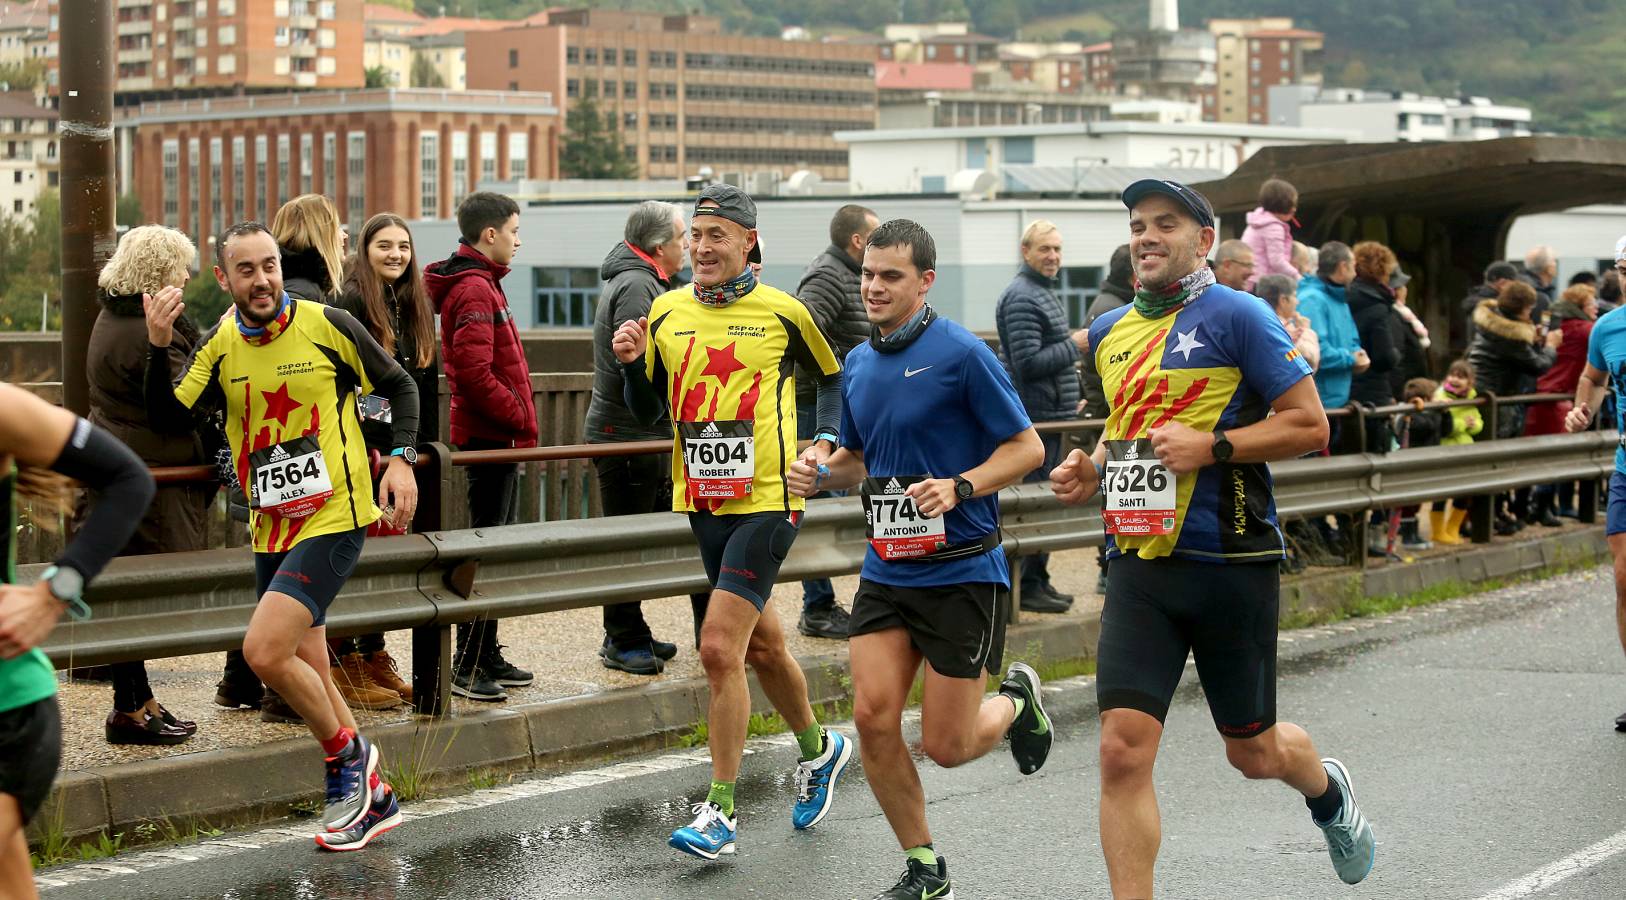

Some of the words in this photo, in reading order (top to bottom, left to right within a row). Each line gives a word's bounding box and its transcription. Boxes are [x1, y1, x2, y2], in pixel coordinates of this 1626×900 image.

[728, 325, 766, 333] esport
[1110, 351, 1131, 364] CAT
[277, 361, 312, 370] esport
[276, 367, 314, 376] independent
[269, 452, 291, 463] adidas
[687, 441, 748, 465] 7604
[258, 457, 320, 493] 7564
[699, 468, 736, 477] ROBERT
[1107, 464, 1167, 492] 7526
[1119, 498, 1145, 507] SANTI
[883, 525, 928, 536] ANTONIO
